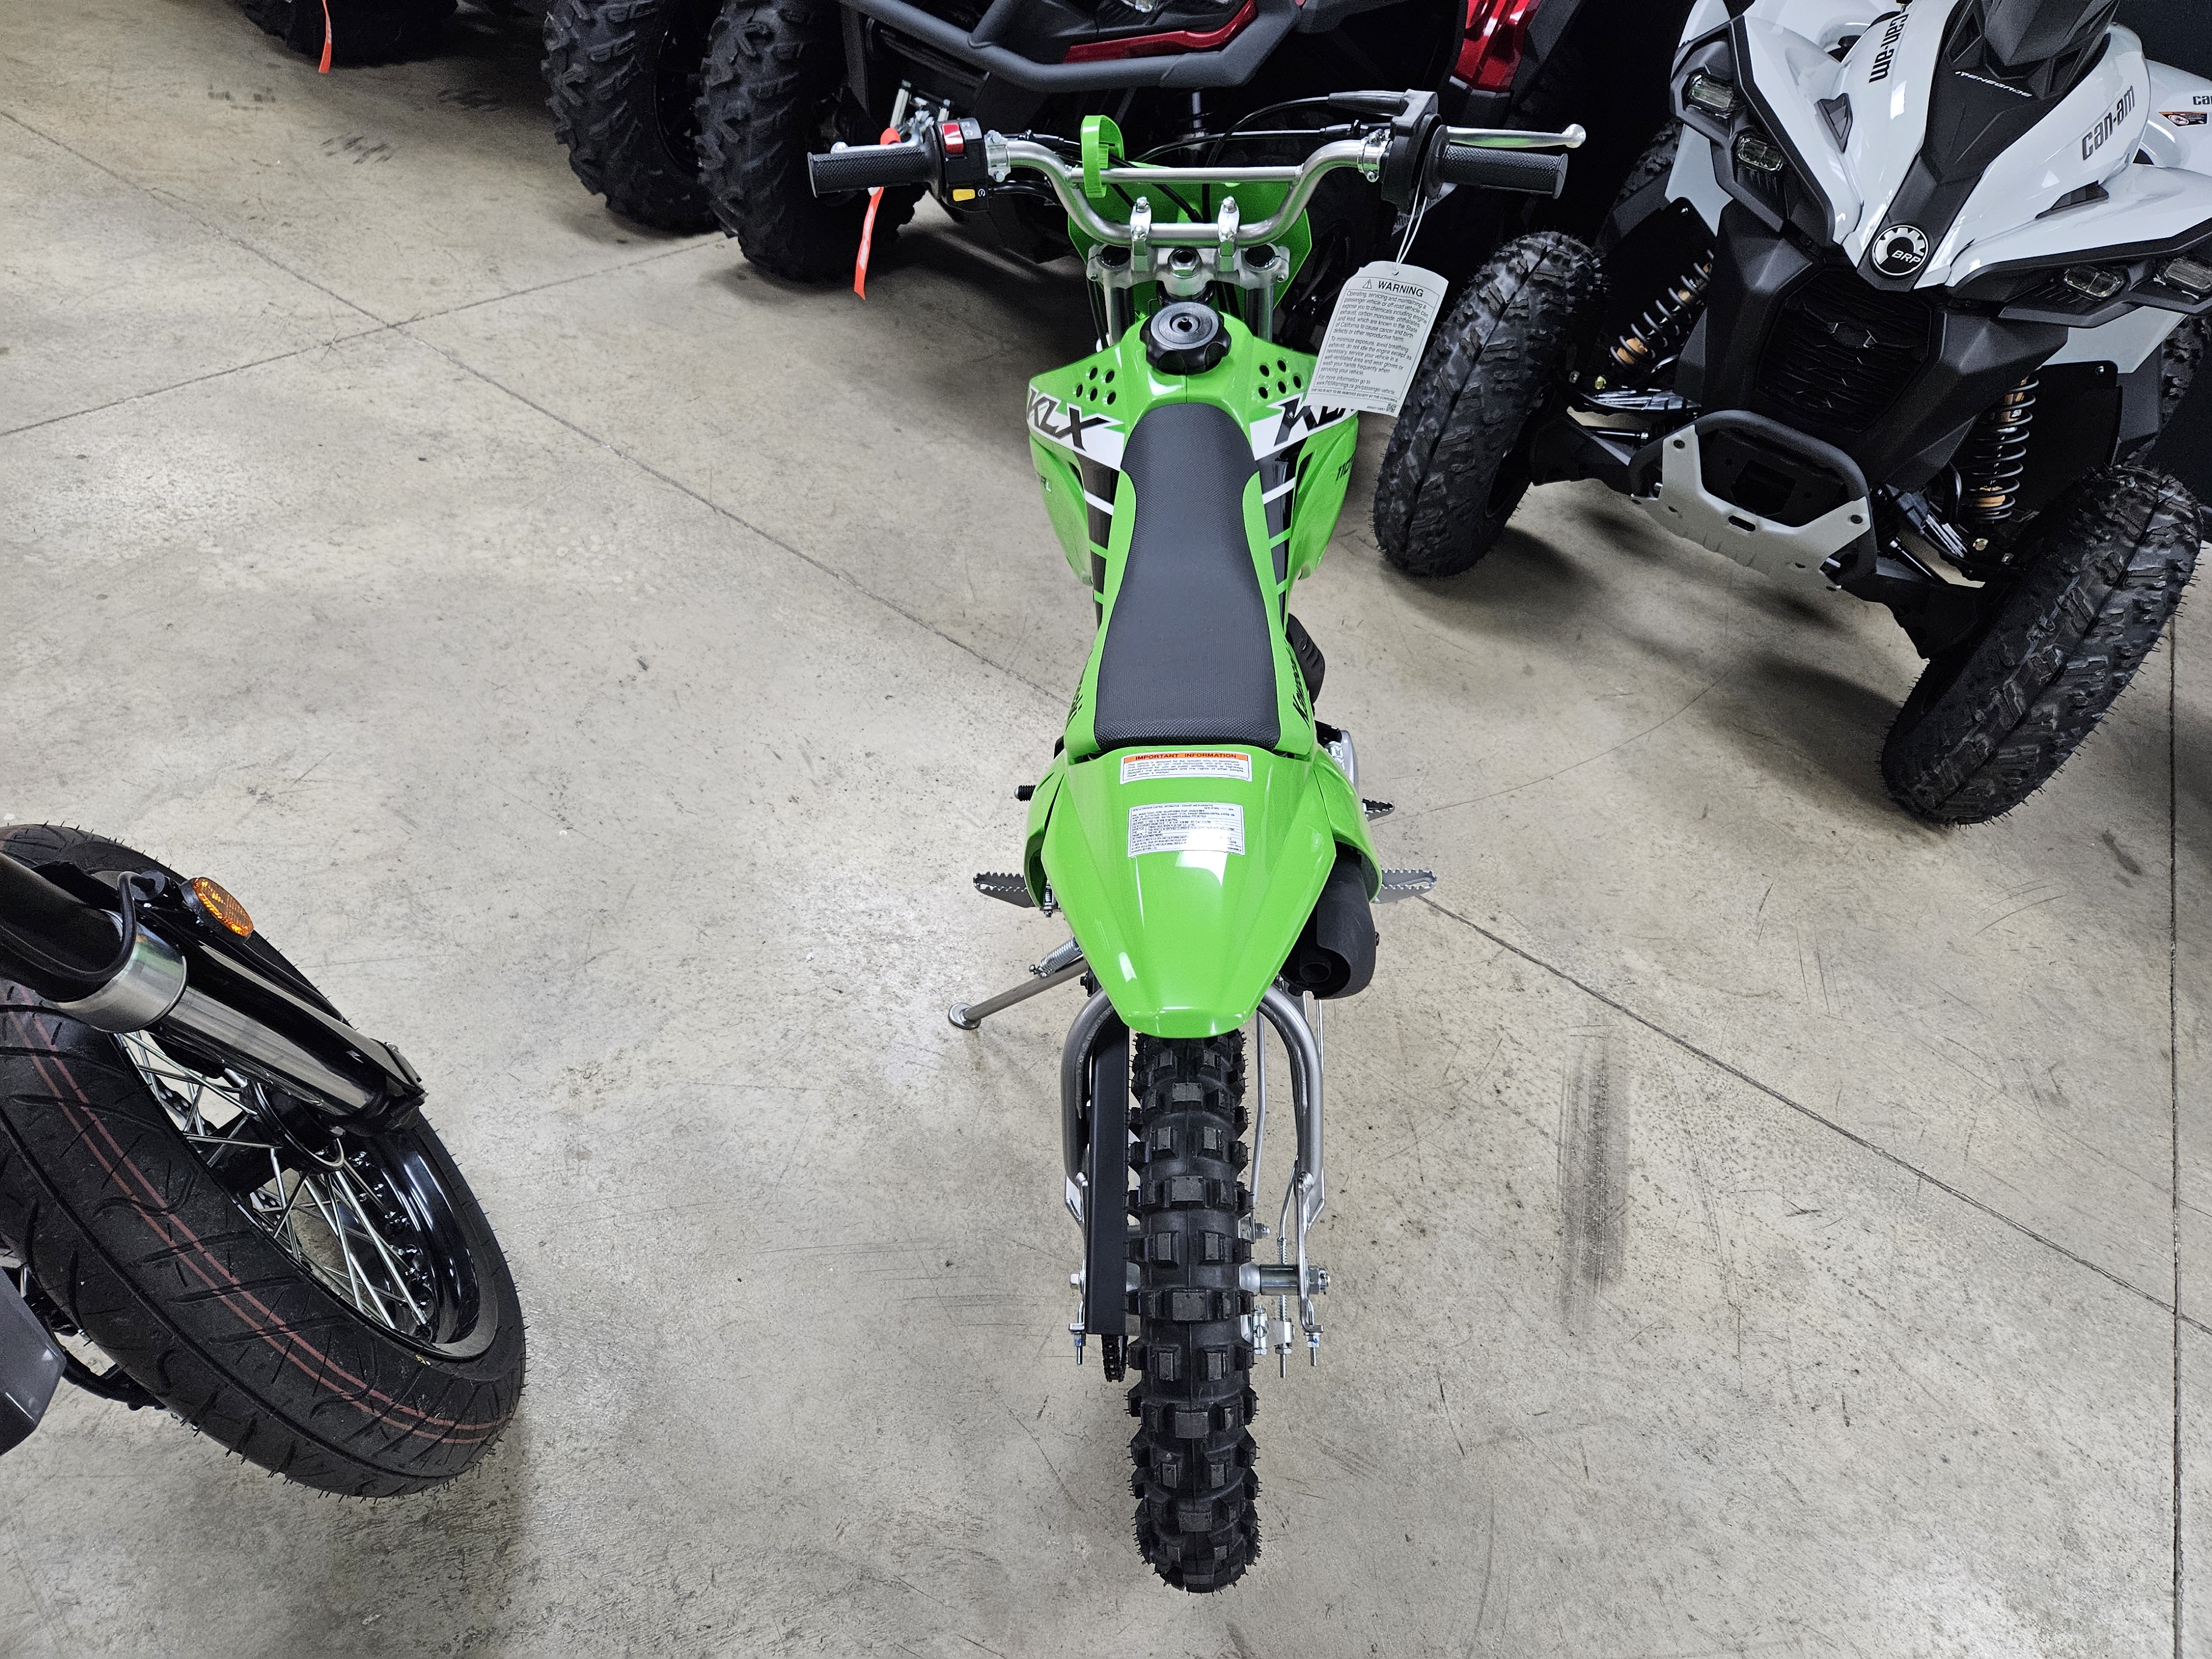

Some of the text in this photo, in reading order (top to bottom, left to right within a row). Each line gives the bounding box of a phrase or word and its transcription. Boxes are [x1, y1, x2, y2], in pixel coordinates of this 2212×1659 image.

[1869, 14, 1909, 83] can-am
[2193, 96, 2212, 105] ca
[2081, 85, 2135, 161] can-am
[1891, 250, 1921, 263] BRP
[1379, 281, 1423, 298] WARNING
[1370, 305, 1392, 314] chemicals
[1393, 310, 1412, 319] including
[1413, 315, 1427, 325] engine
[1026, 388, 1112, 452] KLX
